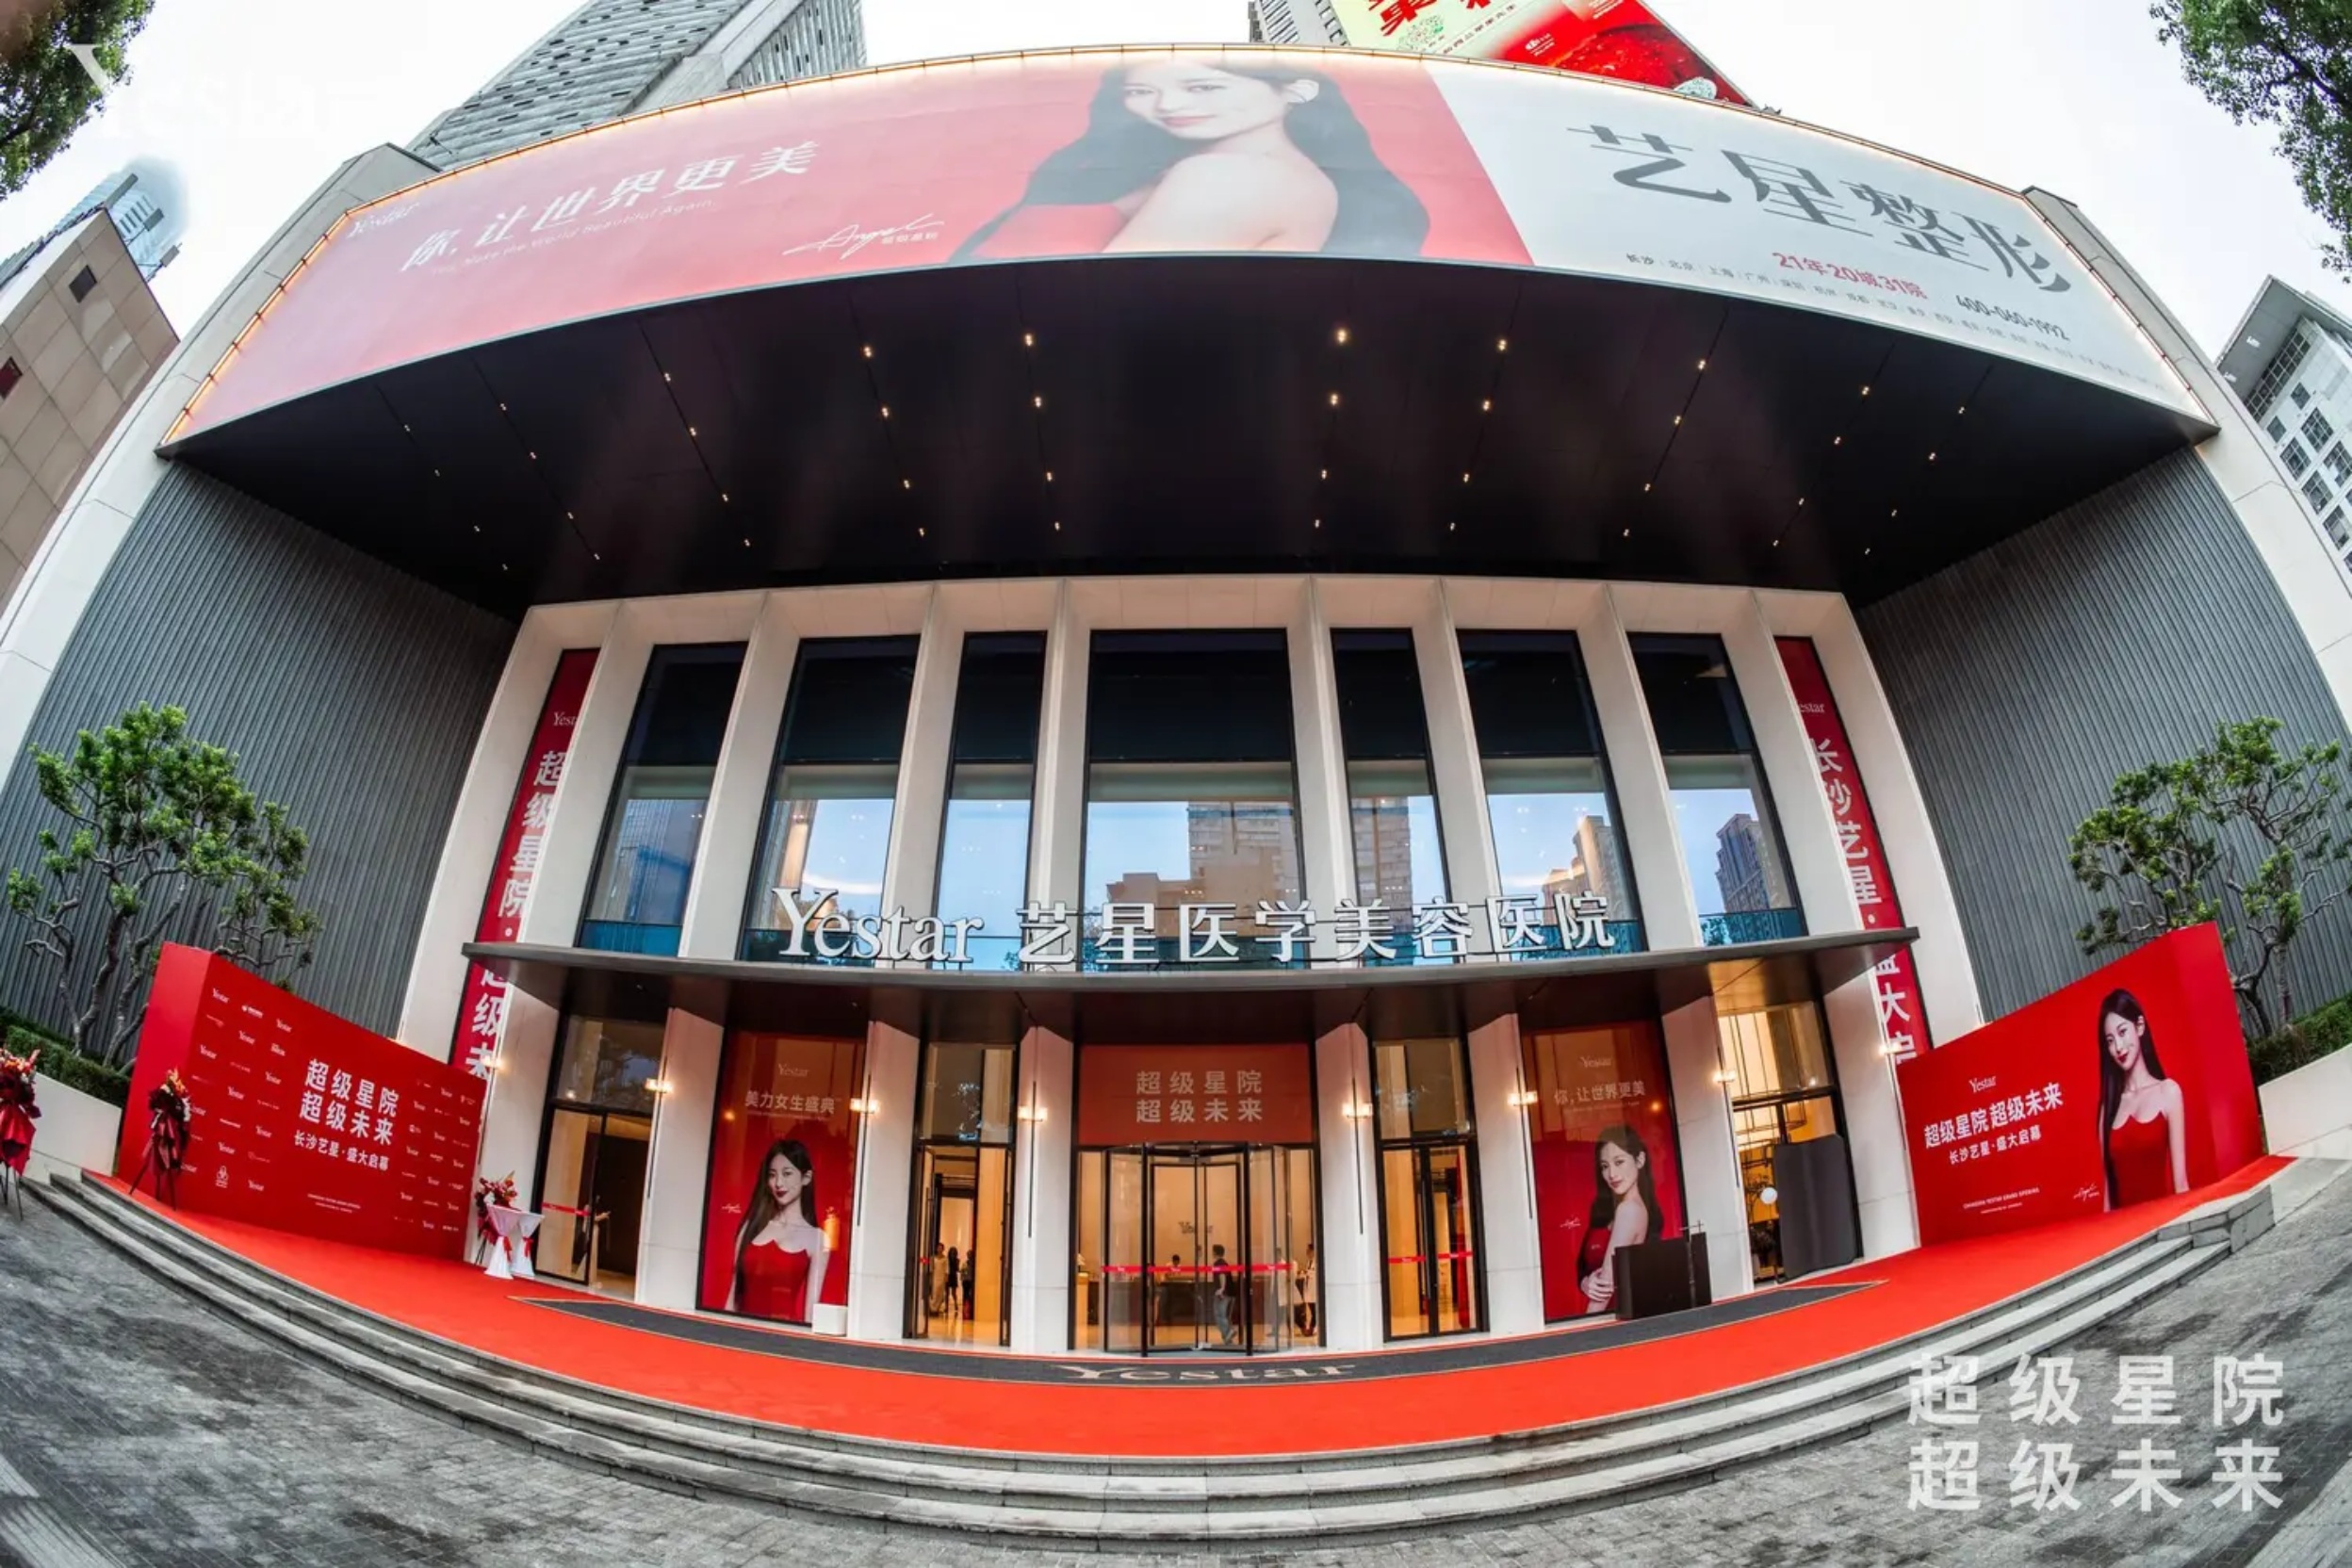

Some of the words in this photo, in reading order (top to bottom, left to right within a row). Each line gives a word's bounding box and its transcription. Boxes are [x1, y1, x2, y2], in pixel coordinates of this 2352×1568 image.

[1566, 124, 2072, 293] 艺星整形
[772, 887, 985, 964] Yestar
[1016, 890, 1615, 966] 艺星医学美容医院
[304, 1058, 400, 1118] 超级星院
[1135, 1070, 1264, 1096] 超级星院
[1135, 1099, 1264, 1123] 超级未来
[1969, 1075, 1997, 1093] Yestar
[300, 1090, 394, 1146] 超级未来
[1054, 1364, 1356, 1380] Yestar
